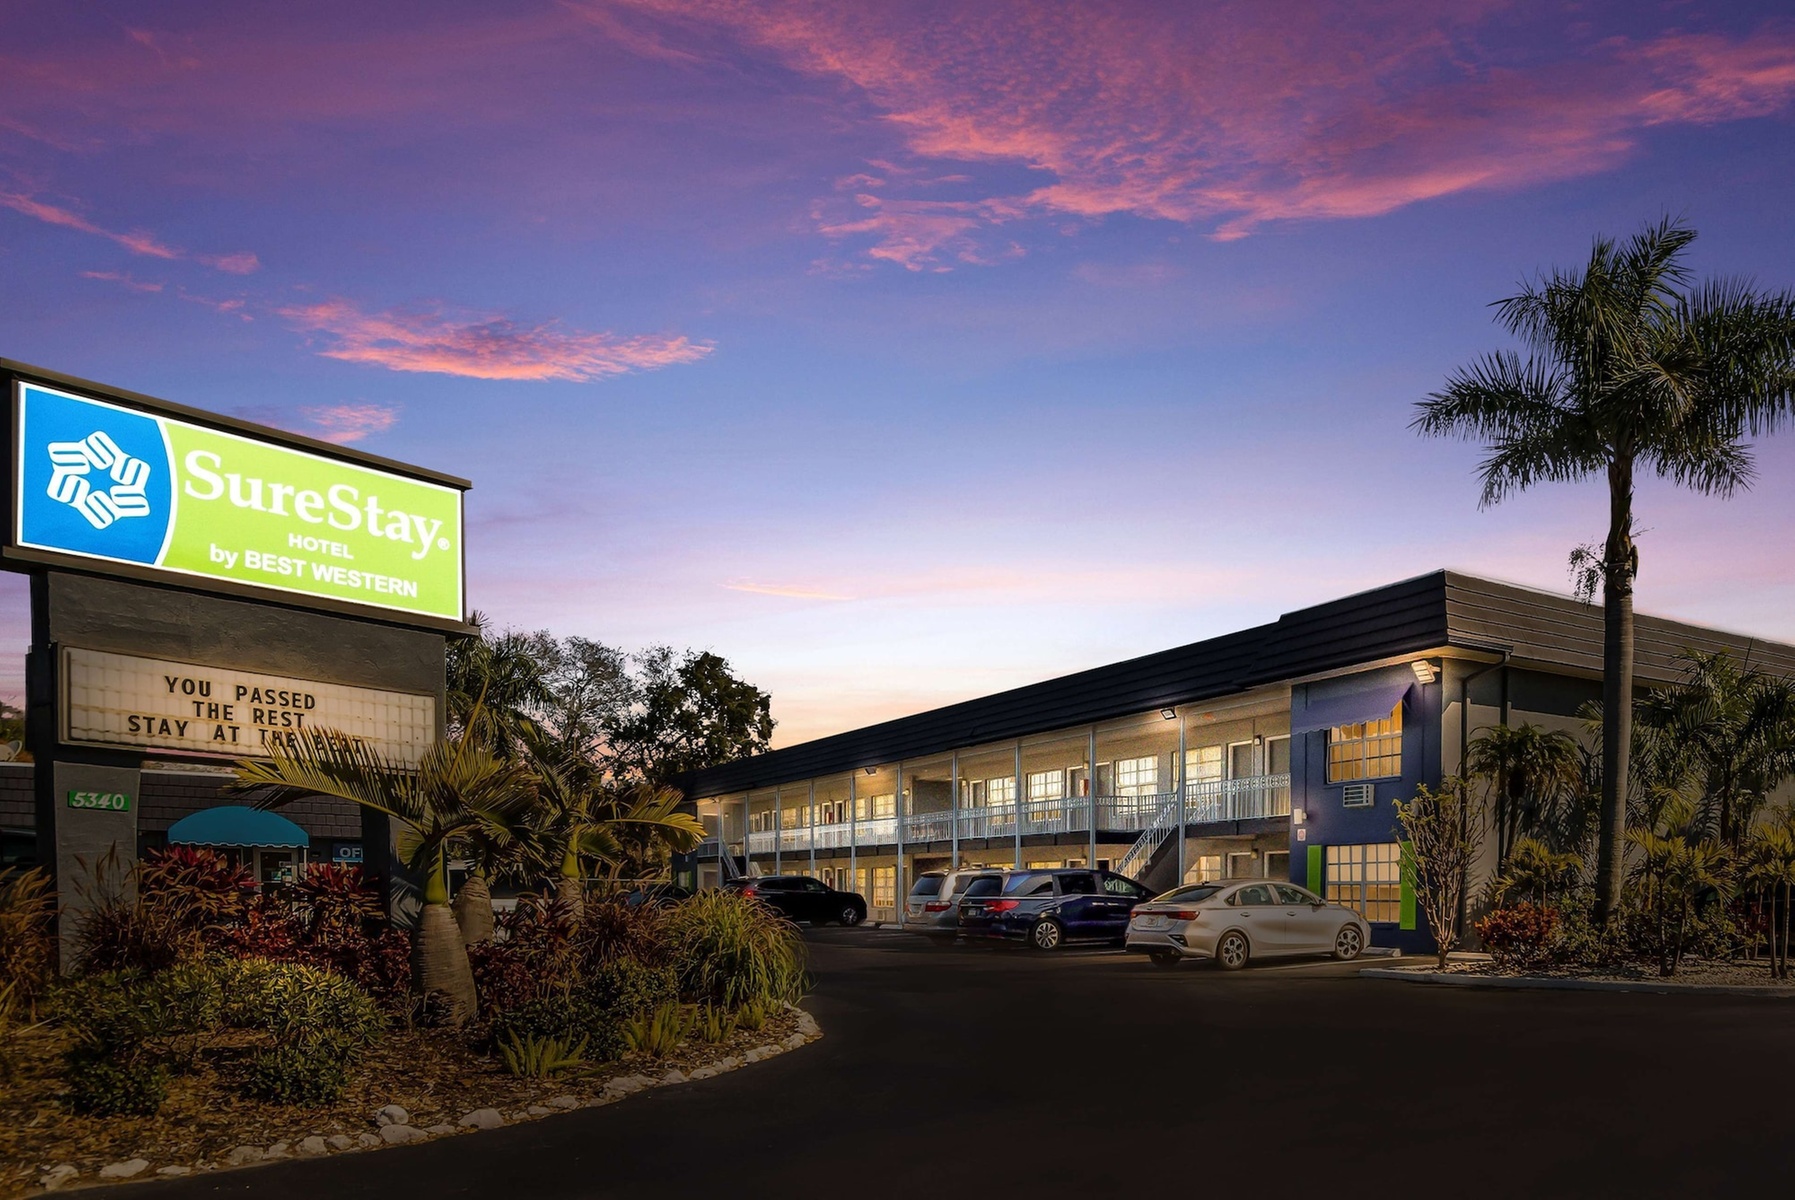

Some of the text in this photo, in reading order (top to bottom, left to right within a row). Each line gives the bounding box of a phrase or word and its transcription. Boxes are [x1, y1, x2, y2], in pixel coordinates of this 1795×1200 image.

[288, 533, 354, 559] HOTEL
[210, 543, 417, 598] by BEST WESTERN
[164, 675, 316, 710] YOU PASSED
[128, 715, 189, 737] STAY
[213, 724, 240, 743] AT
[192, 701, 305, 729] THE REST
[72, 792, 125, 810] 5340
[339, 847, 364, 859] OF
